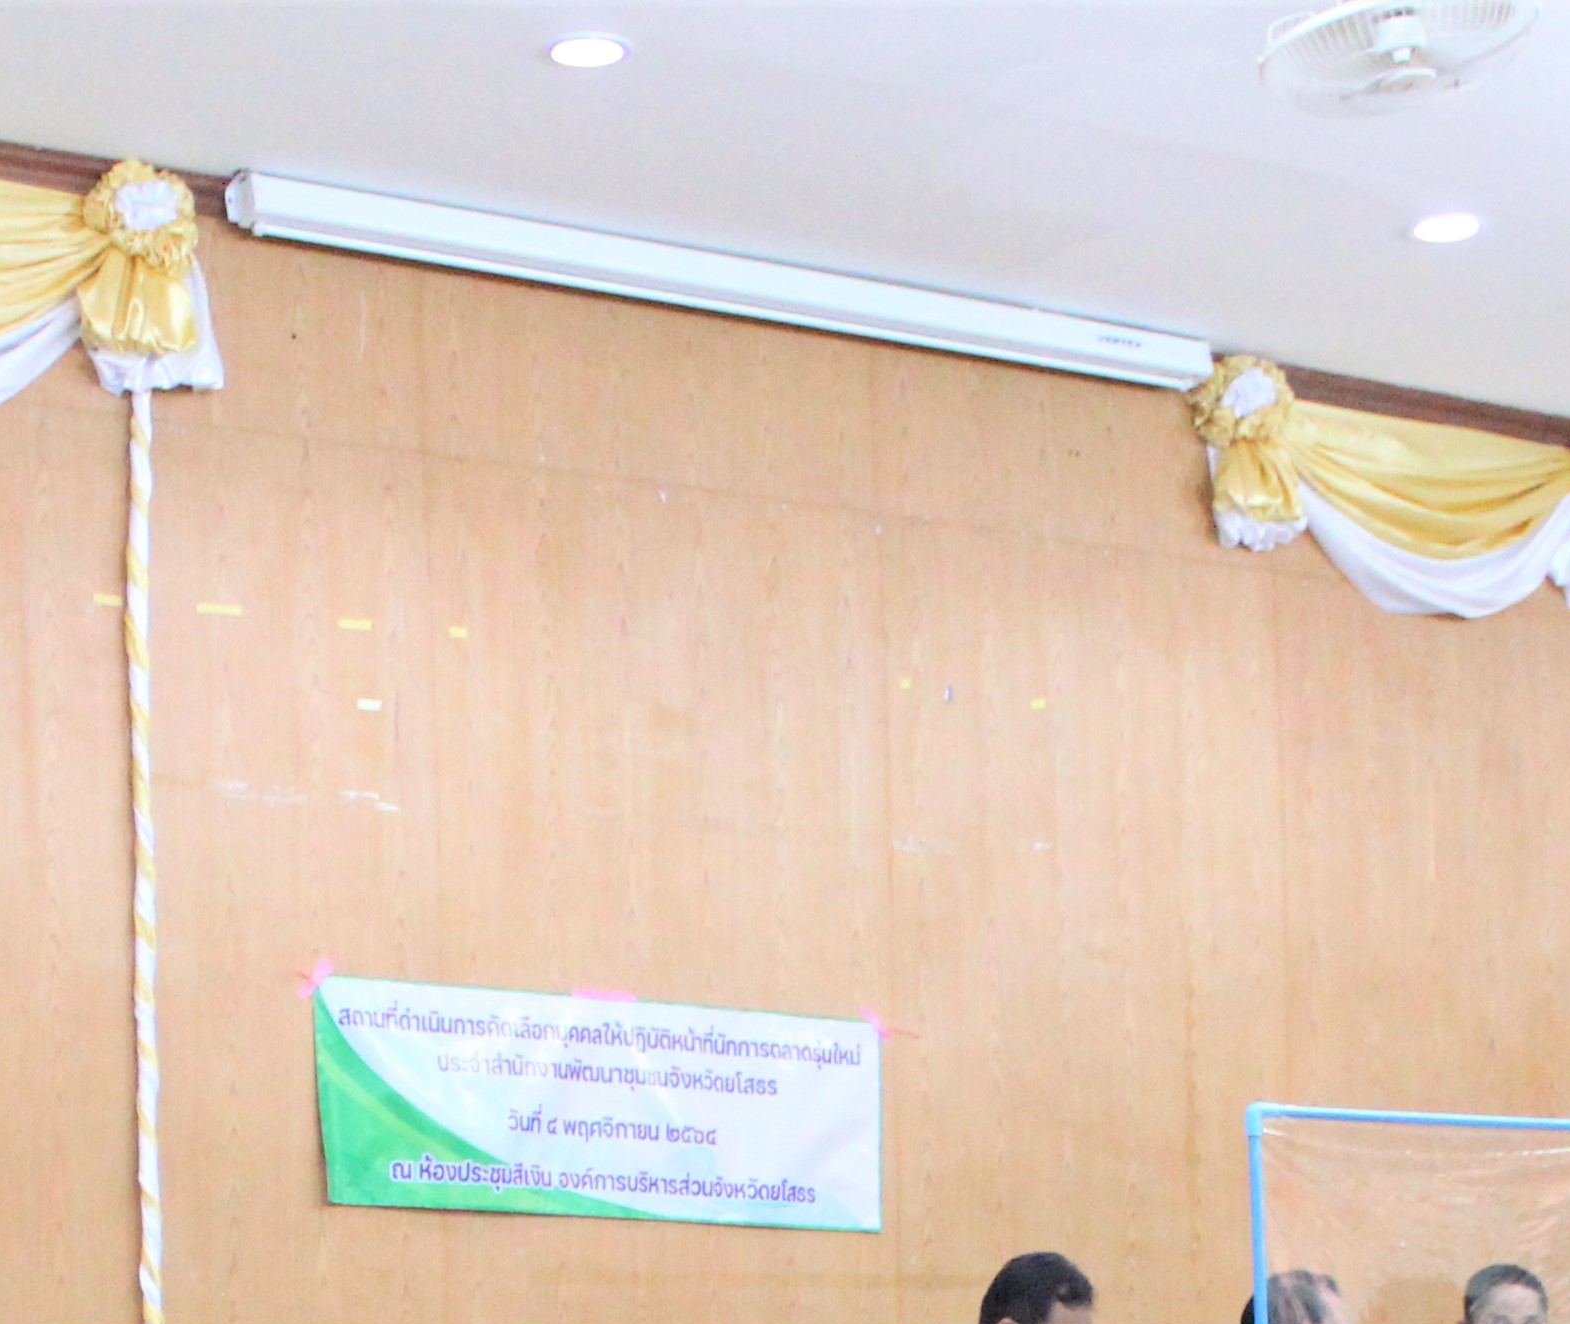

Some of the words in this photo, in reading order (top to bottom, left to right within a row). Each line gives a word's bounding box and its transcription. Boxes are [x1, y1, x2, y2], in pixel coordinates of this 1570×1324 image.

[508, 1103, 542, 1134] วันที่
[563, 1116, 660, 1142] พฤศจิกายน
[392, 1161, 412, 1181] ณ
[558, 1167, 817, 1203] องค์การบริหารส่วนจังหวัดยโสธร
